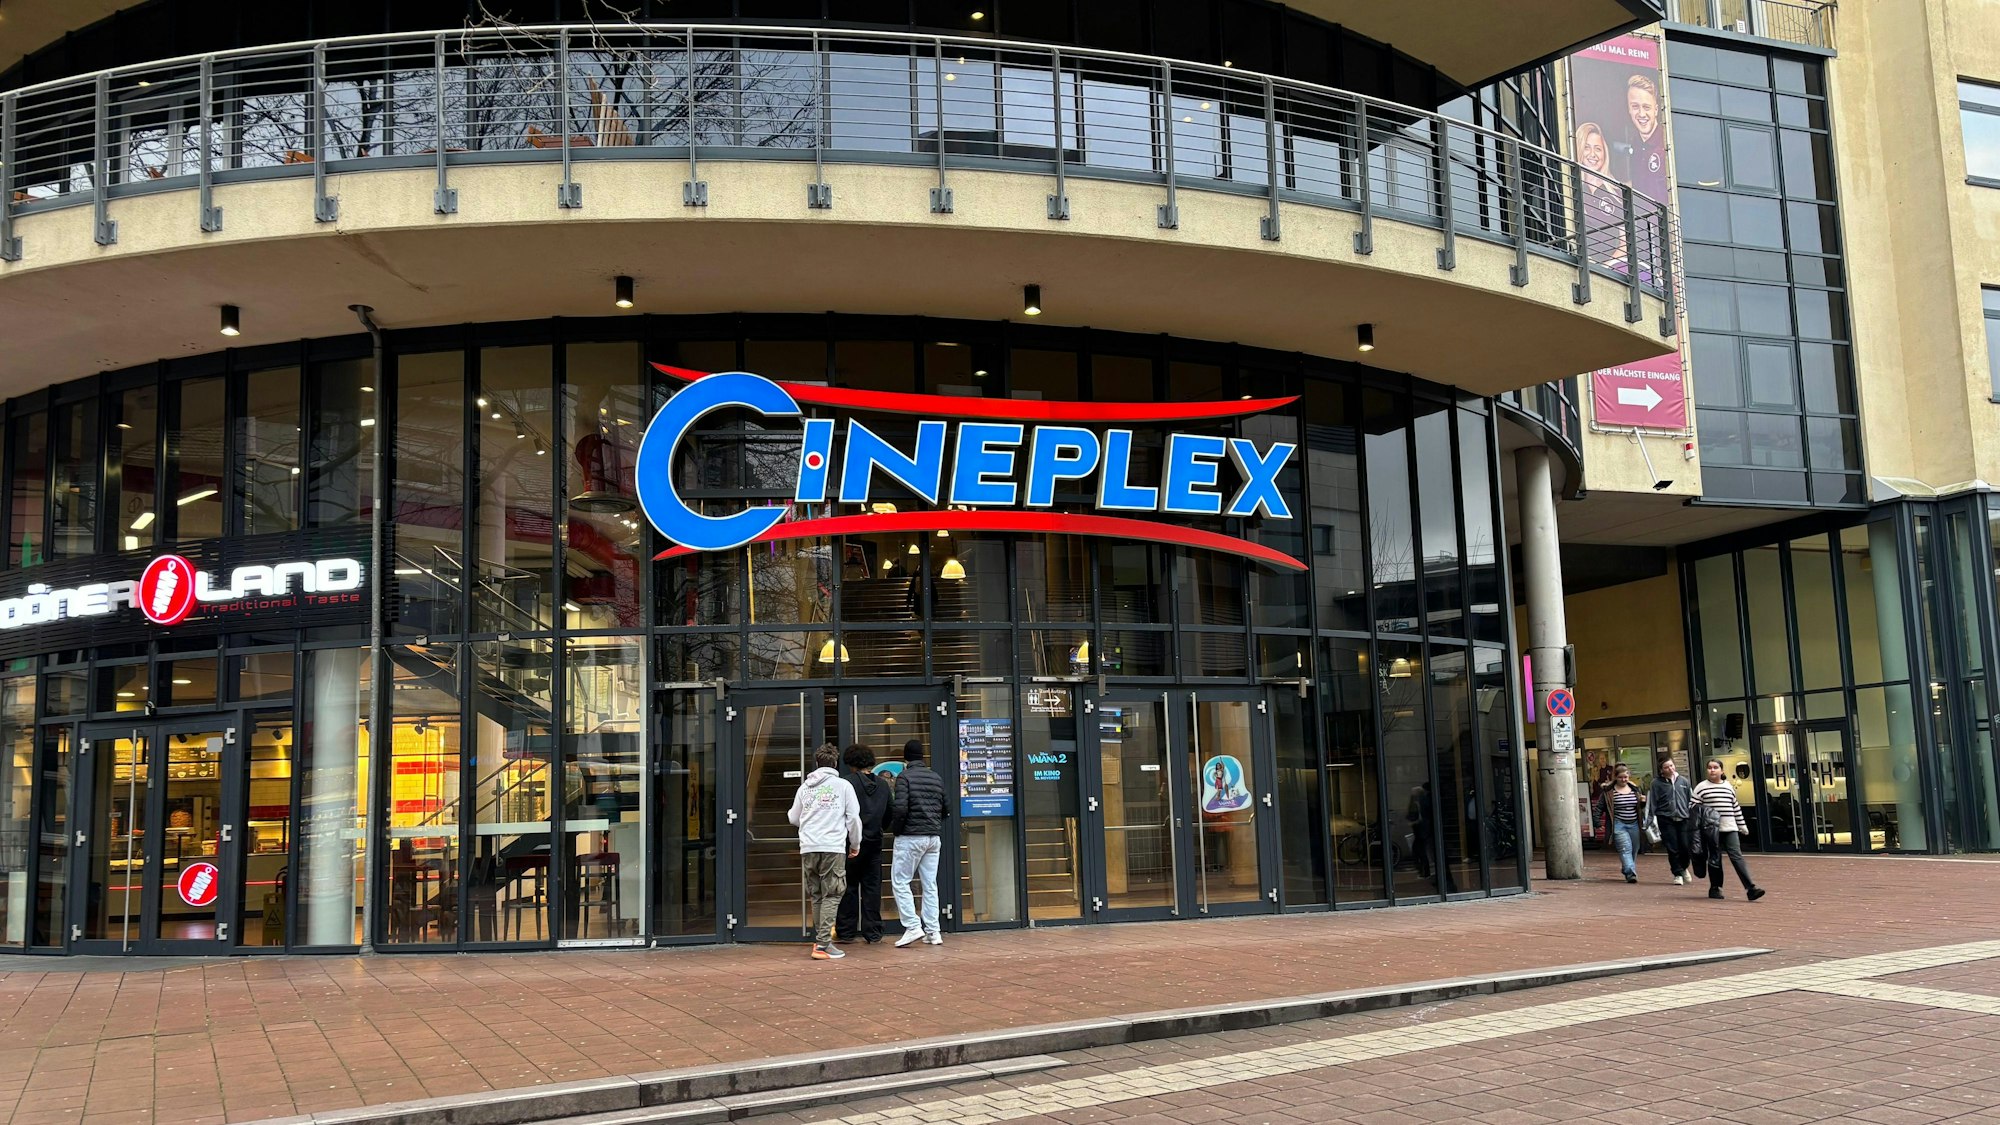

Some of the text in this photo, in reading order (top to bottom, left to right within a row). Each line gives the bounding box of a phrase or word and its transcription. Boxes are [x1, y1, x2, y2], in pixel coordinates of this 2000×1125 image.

[1608, 45, 1627, 56] MAL
[1628, 48, 1649, 60] REIN!
[1597, 367, 1681, 381] DER NÄCHSTE EINGANG
[635, 371, 1297, 551] CINEPLEX
[194, 558, 362, 601] LAND
[200, 593, 361, 613] Traditional Taste
[1058, 753, 1068, 764] 2
